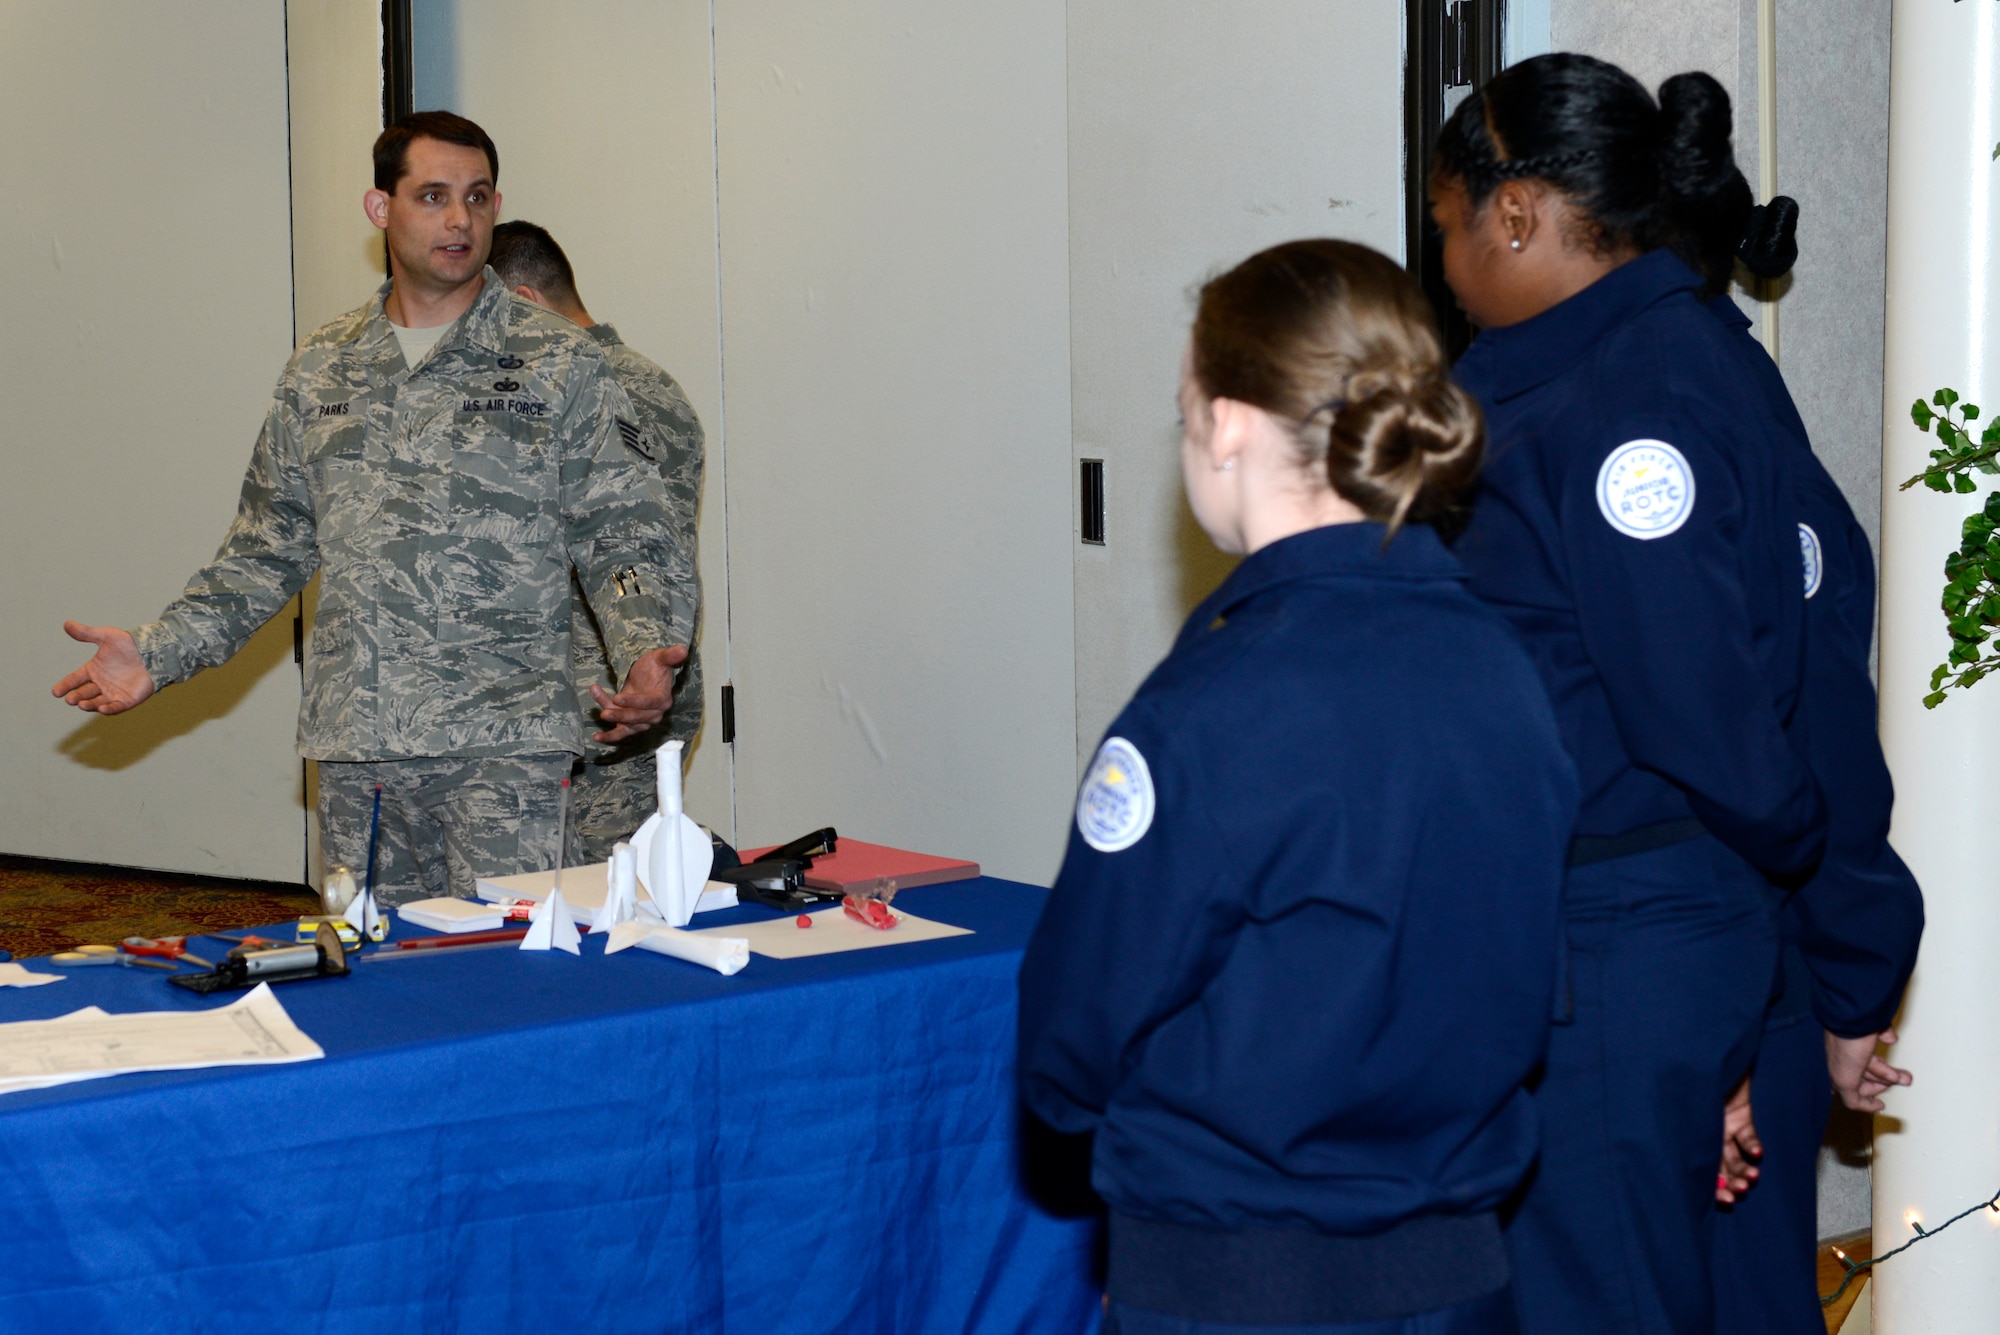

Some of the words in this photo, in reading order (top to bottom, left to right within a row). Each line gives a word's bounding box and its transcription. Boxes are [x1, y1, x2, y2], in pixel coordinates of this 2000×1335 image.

[318, 402, 349, 418] PARKS
[463, 400, 482, 412] U.S.
[486, 399, 505, 412] AIR
[508, 400, 544, 416] FORCE
[1619, 485, 1681, 515] ROTC
